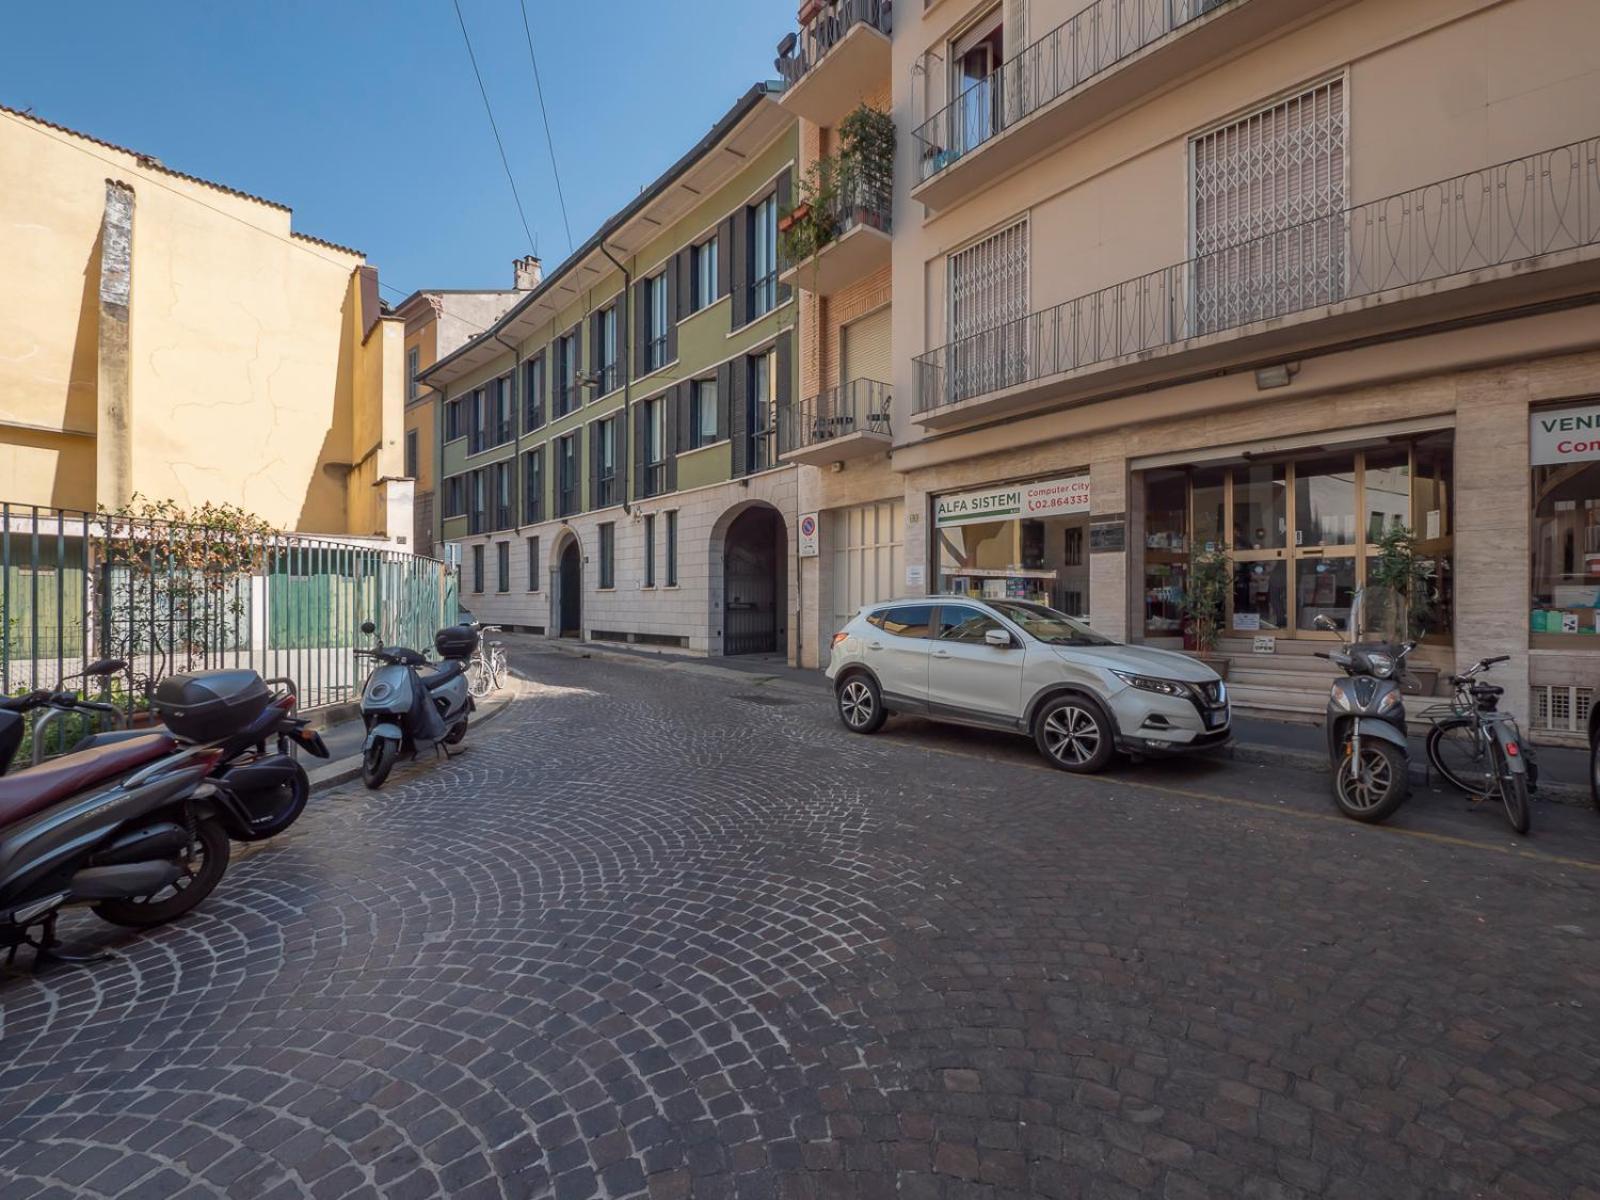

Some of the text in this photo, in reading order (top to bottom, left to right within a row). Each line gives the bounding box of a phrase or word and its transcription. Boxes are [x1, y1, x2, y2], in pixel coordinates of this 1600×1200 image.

[1027, 482, 1090, 498] Computer City
[938, 491, 1021, 514] ALFA SISTEMI
